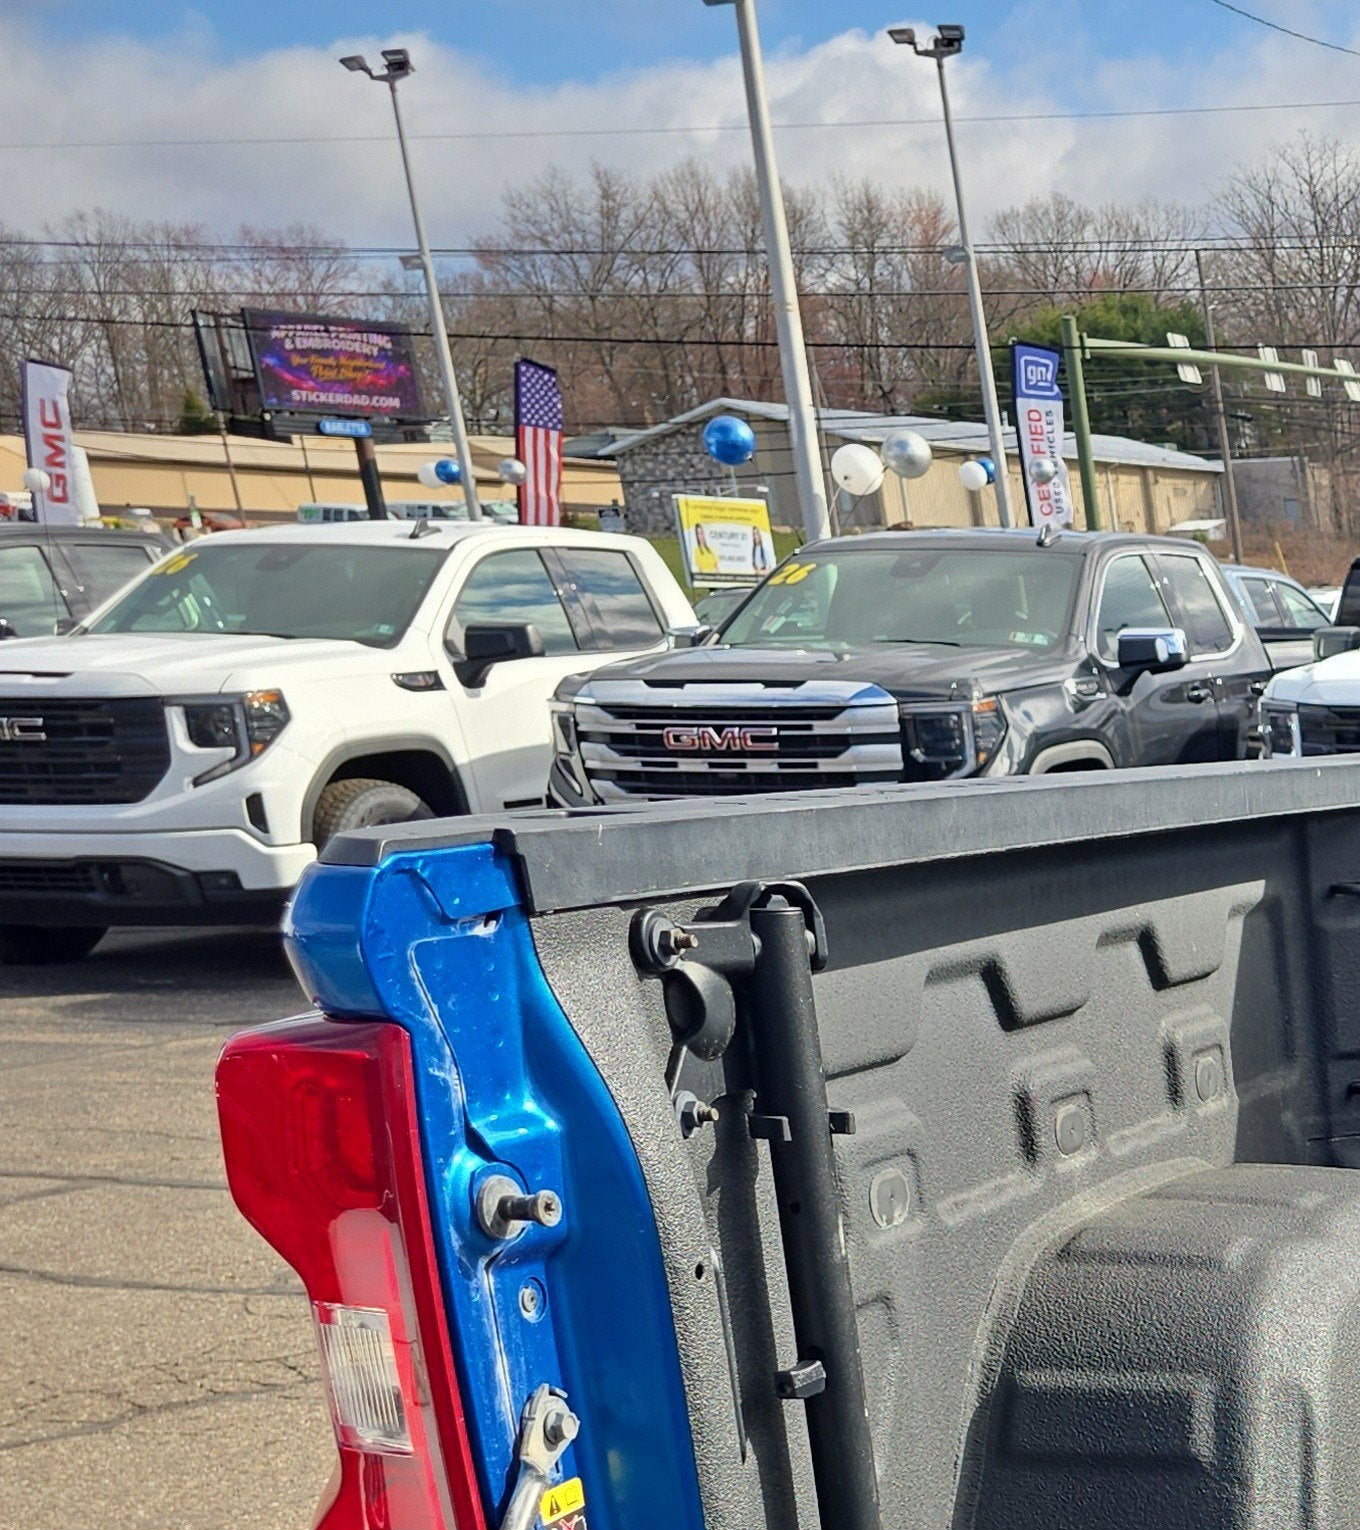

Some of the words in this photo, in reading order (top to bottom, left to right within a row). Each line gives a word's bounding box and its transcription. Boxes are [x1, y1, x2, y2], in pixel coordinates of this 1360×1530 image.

[295, 337, 379, 357] EMBROIDERY
[291, 389, 401, 408] STICKERDAD.COM
[39, 397, 69, 504] GMC
[1027, 409, 1053, 516] CEFIED
[768, 563, 816, 585] 26
[663, 727, 779, 750] GMC
